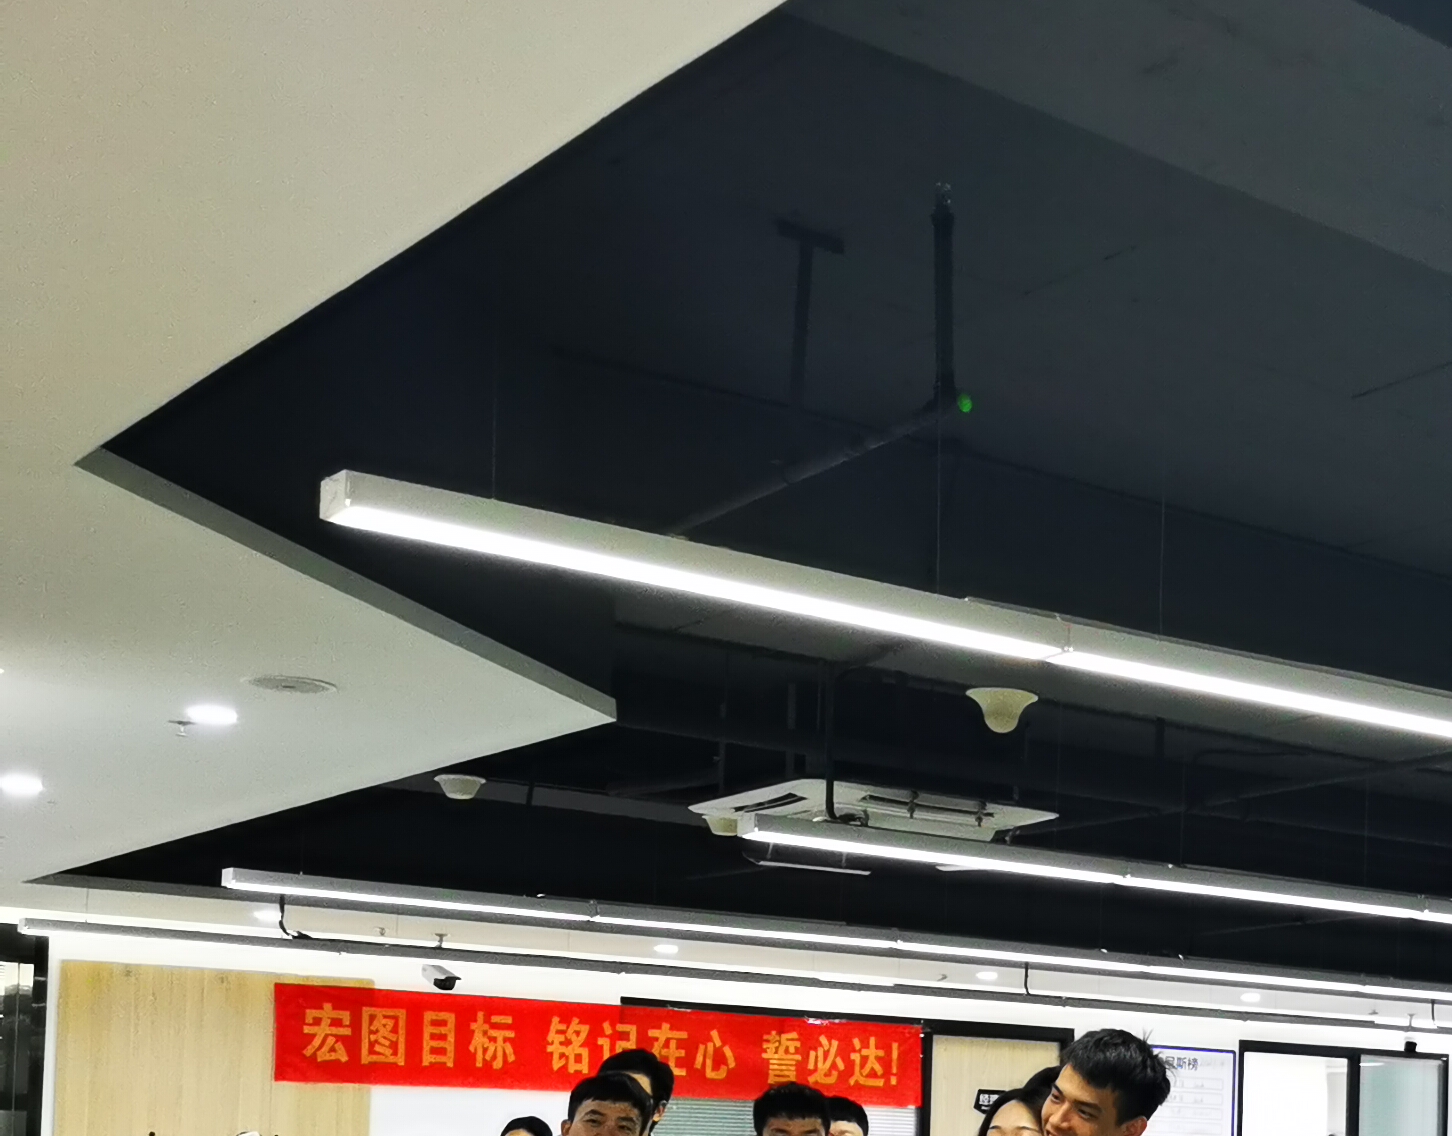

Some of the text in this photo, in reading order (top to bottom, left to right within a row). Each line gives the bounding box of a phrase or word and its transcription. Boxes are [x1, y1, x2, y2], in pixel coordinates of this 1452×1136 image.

[302, 1003, 899, 1087] 宏图目标 铭记在心 誓必达!
